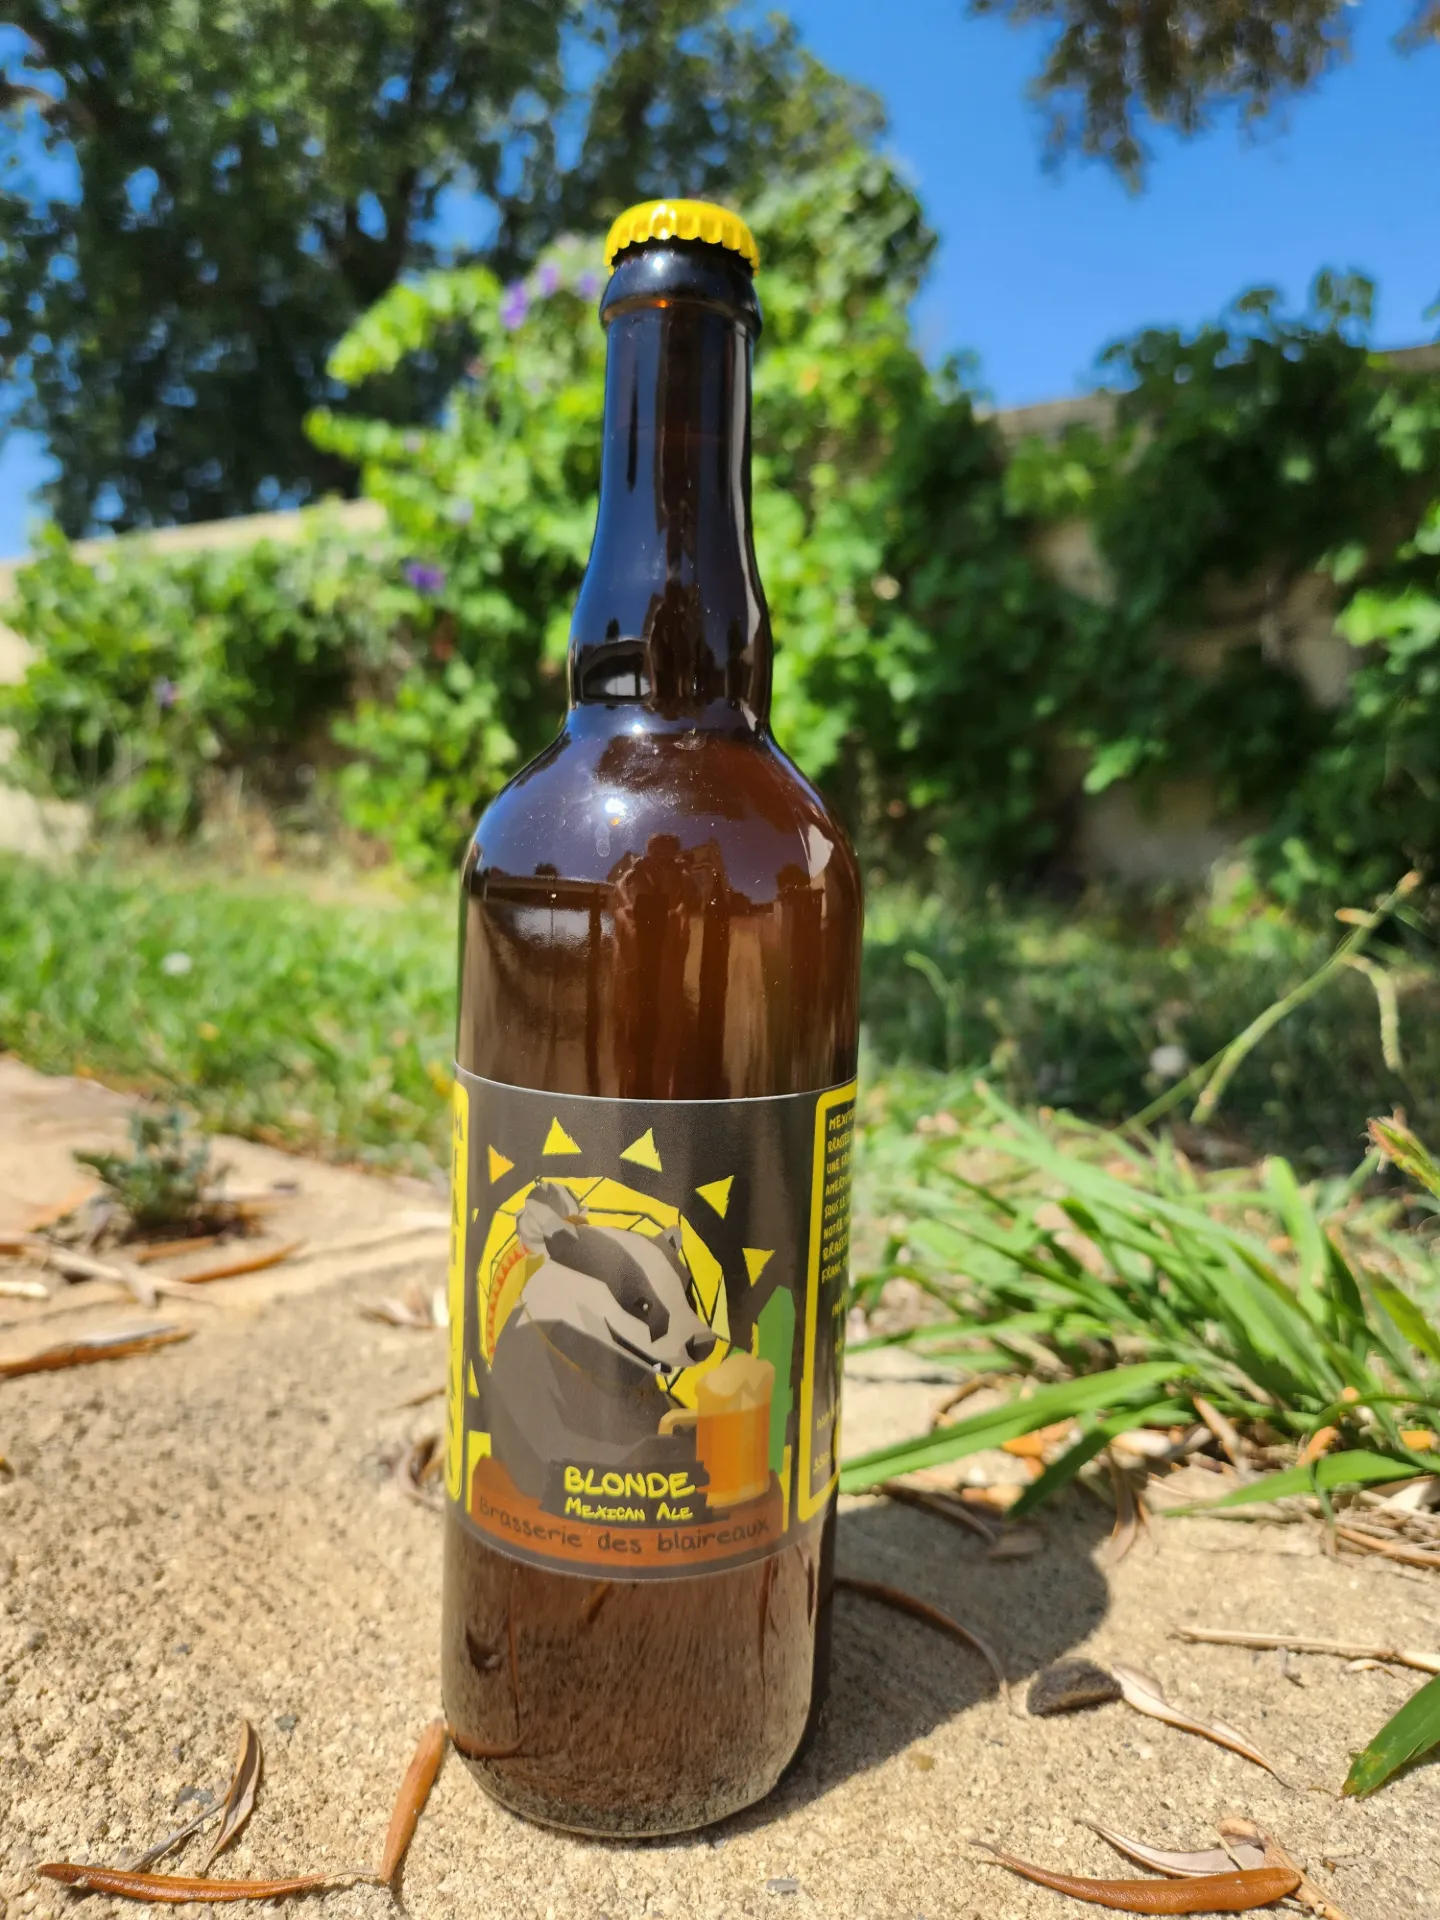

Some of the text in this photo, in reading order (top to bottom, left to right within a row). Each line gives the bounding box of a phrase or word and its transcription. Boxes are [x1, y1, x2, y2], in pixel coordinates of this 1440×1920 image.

[564, 1465, 696, 1498] BLONDE
[479, 1496, 770, 1554] Brasserie des blaireaux
